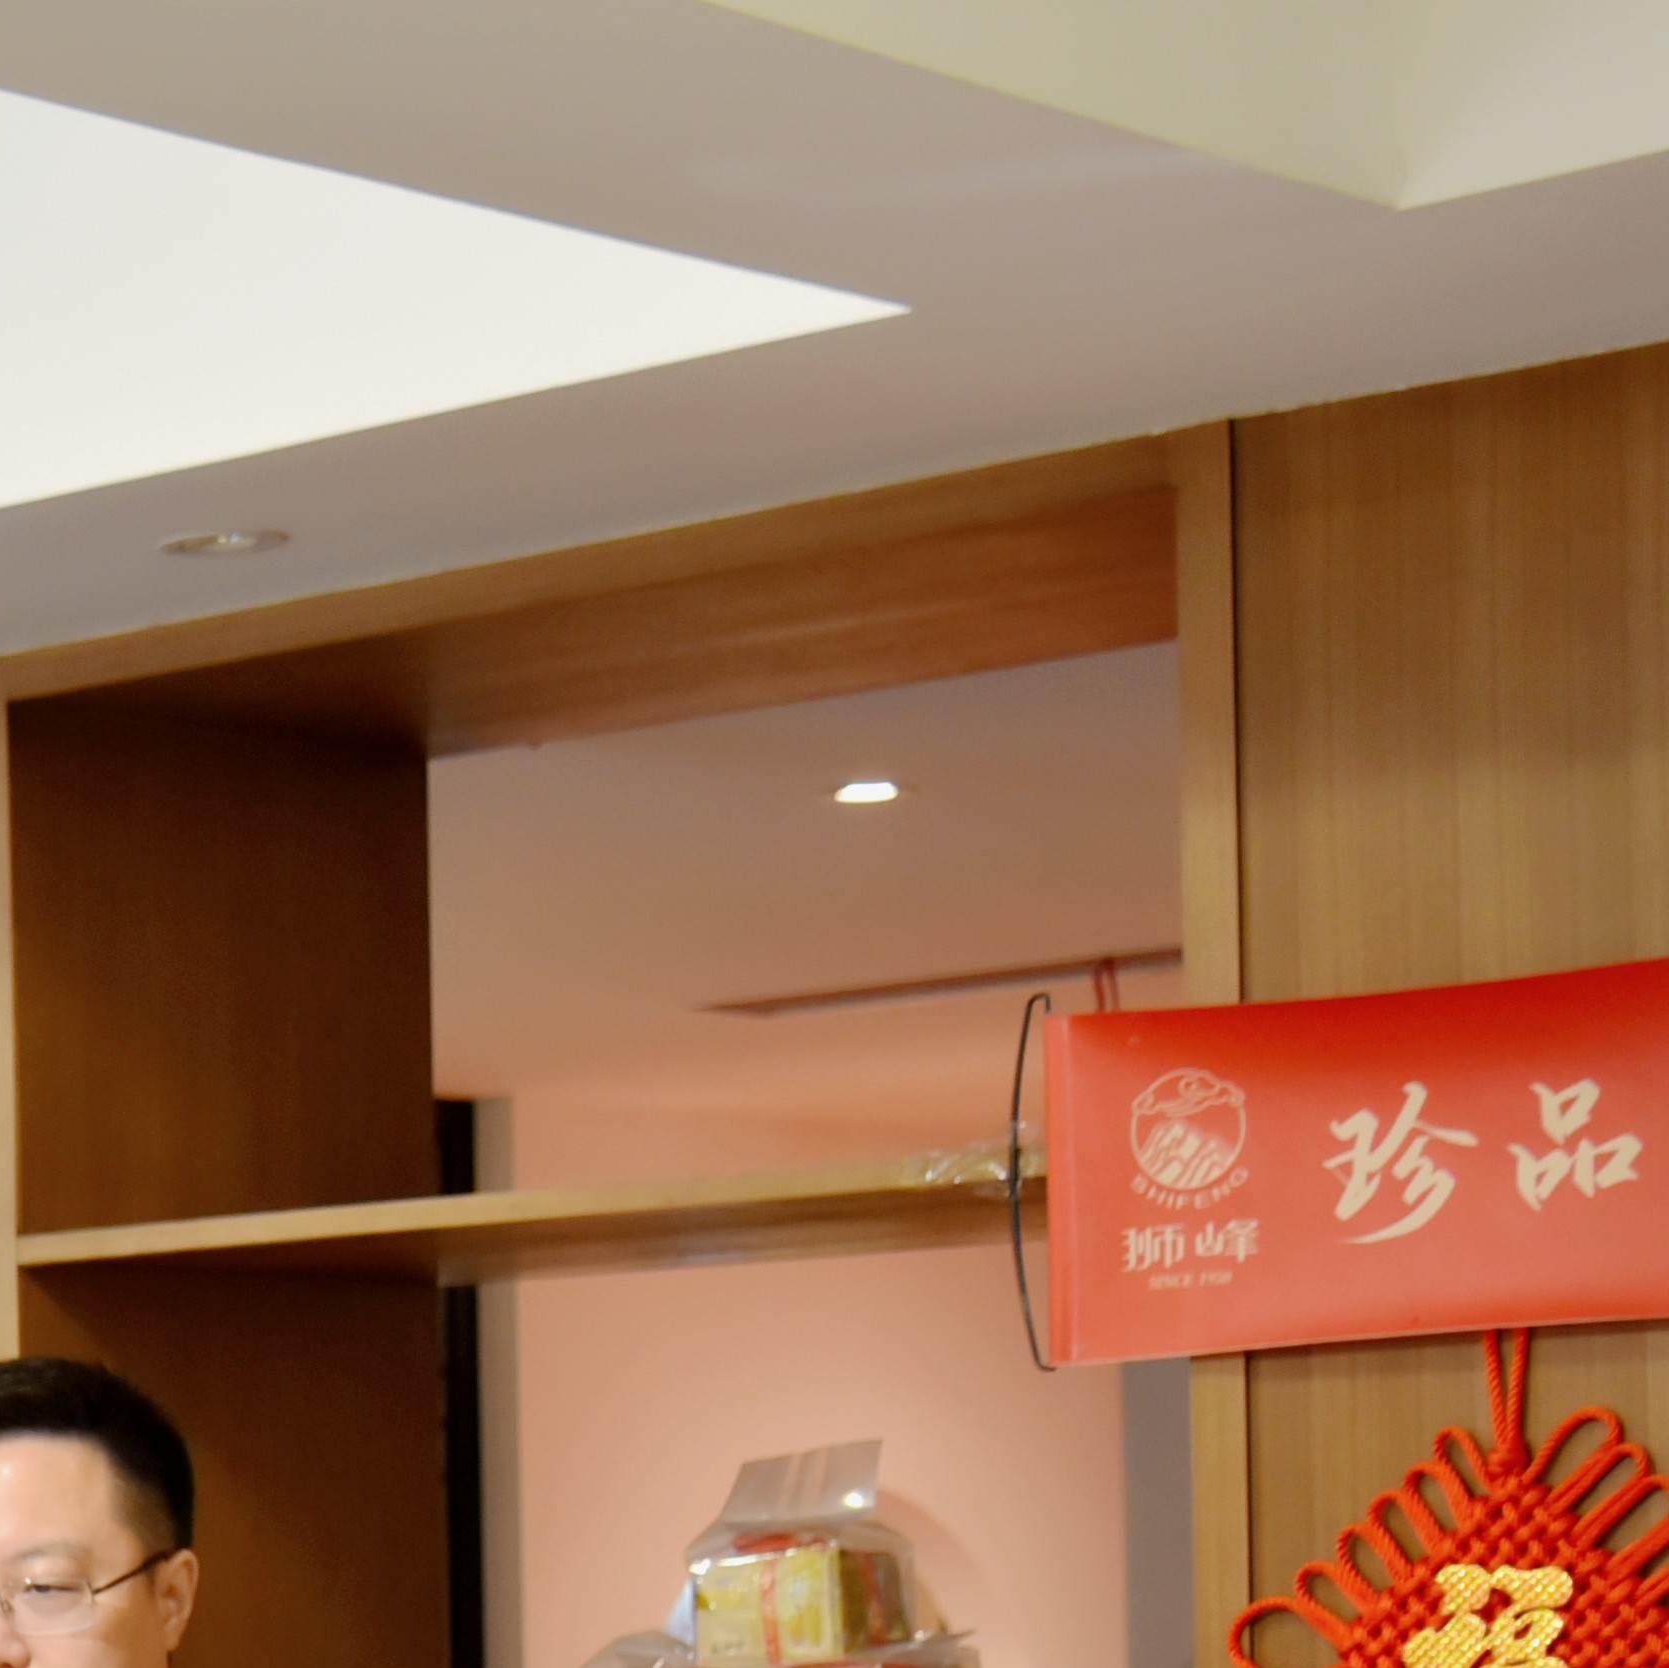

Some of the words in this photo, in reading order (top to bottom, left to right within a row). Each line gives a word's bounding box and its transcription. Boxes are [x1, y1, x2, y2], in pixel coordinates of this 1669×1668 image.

[1130, 1168, 1249, 1209] SHIFENG
[1322, 1079, 1643, 1245] 珍品
[1120, 1218, 1260, 1273] 狮峰
